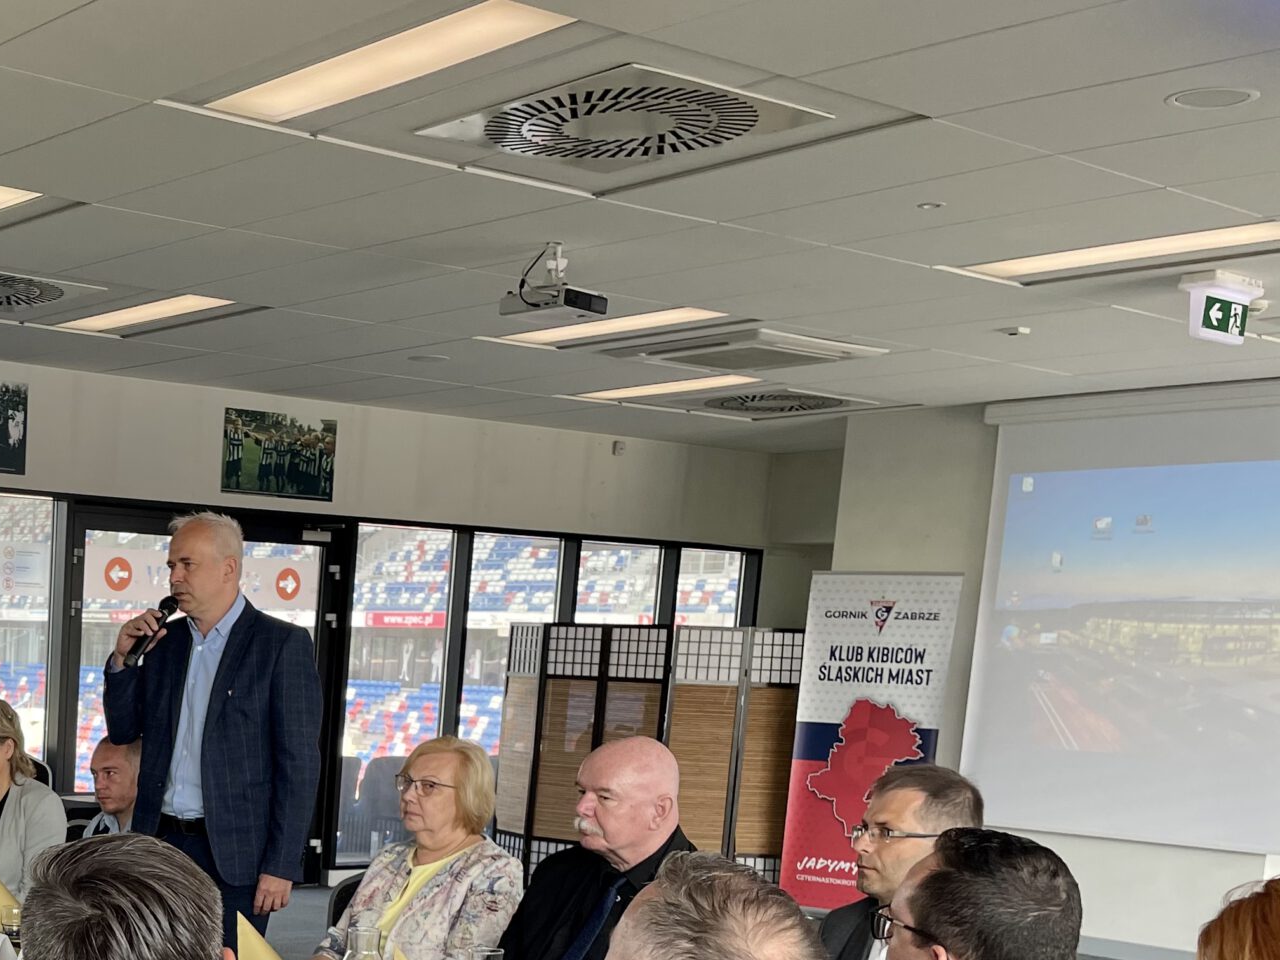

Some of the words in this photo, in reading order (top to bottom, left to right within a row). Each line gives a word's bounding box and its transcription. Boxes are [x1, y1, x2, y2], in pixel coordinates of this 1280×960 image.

[893, 611, 941, 622] ZABRZE
[829, 645, 864, 662] KLUB
[867, 644, 926, 665] KIBICÓW
[818, 662, 884, 684] ŚLĄSKICH
[887, 668, 934, 686] MIAST
[796, 856, 858, 876] JADYMY
[796, 873, 857, 888] CZTERNASTOKROT
